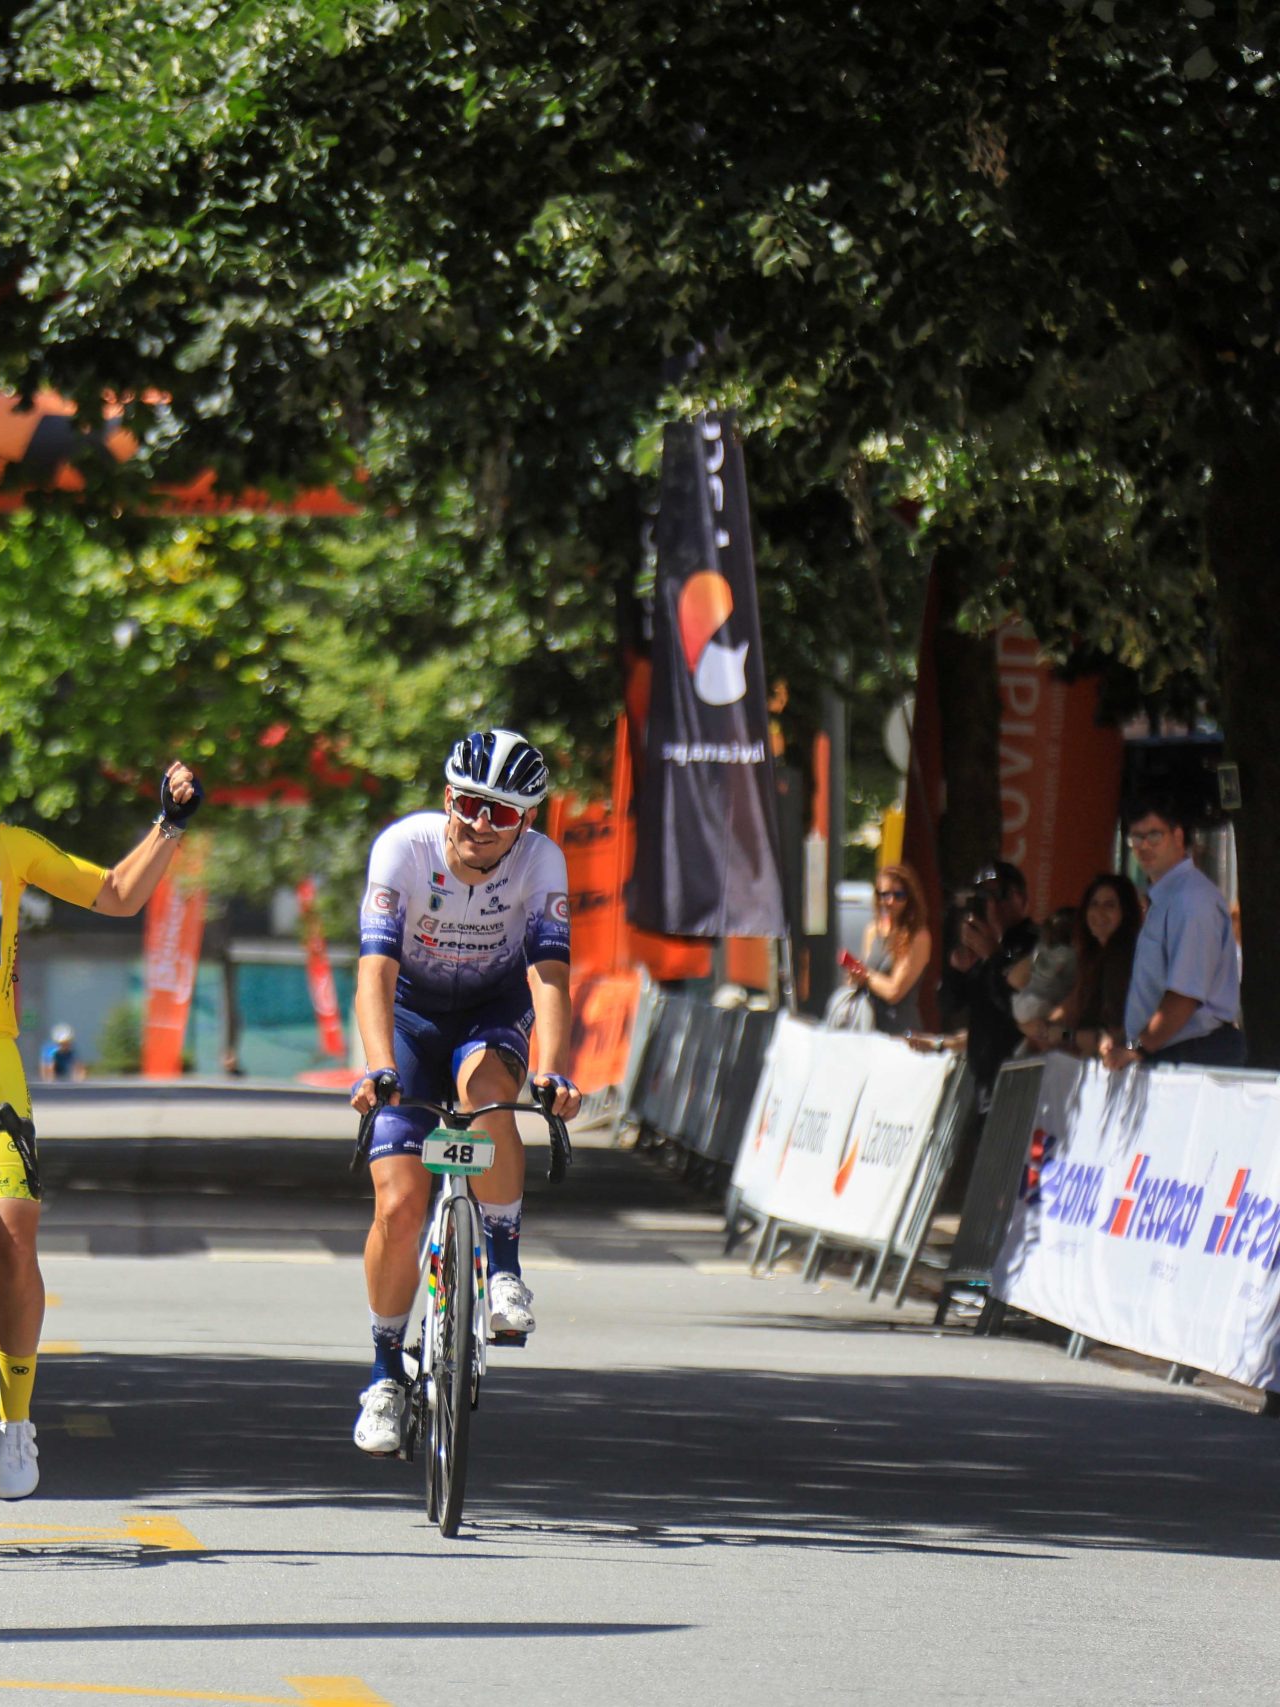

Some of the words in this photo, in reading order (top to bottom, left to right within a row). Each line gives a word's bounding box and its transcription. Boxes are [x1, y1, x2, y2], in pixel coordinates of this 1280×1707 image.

[457, 922, 504, 931] GONÇALVES
[439, 935, 507, 951] reconco
[443, 1144, 474, 1164] 48
